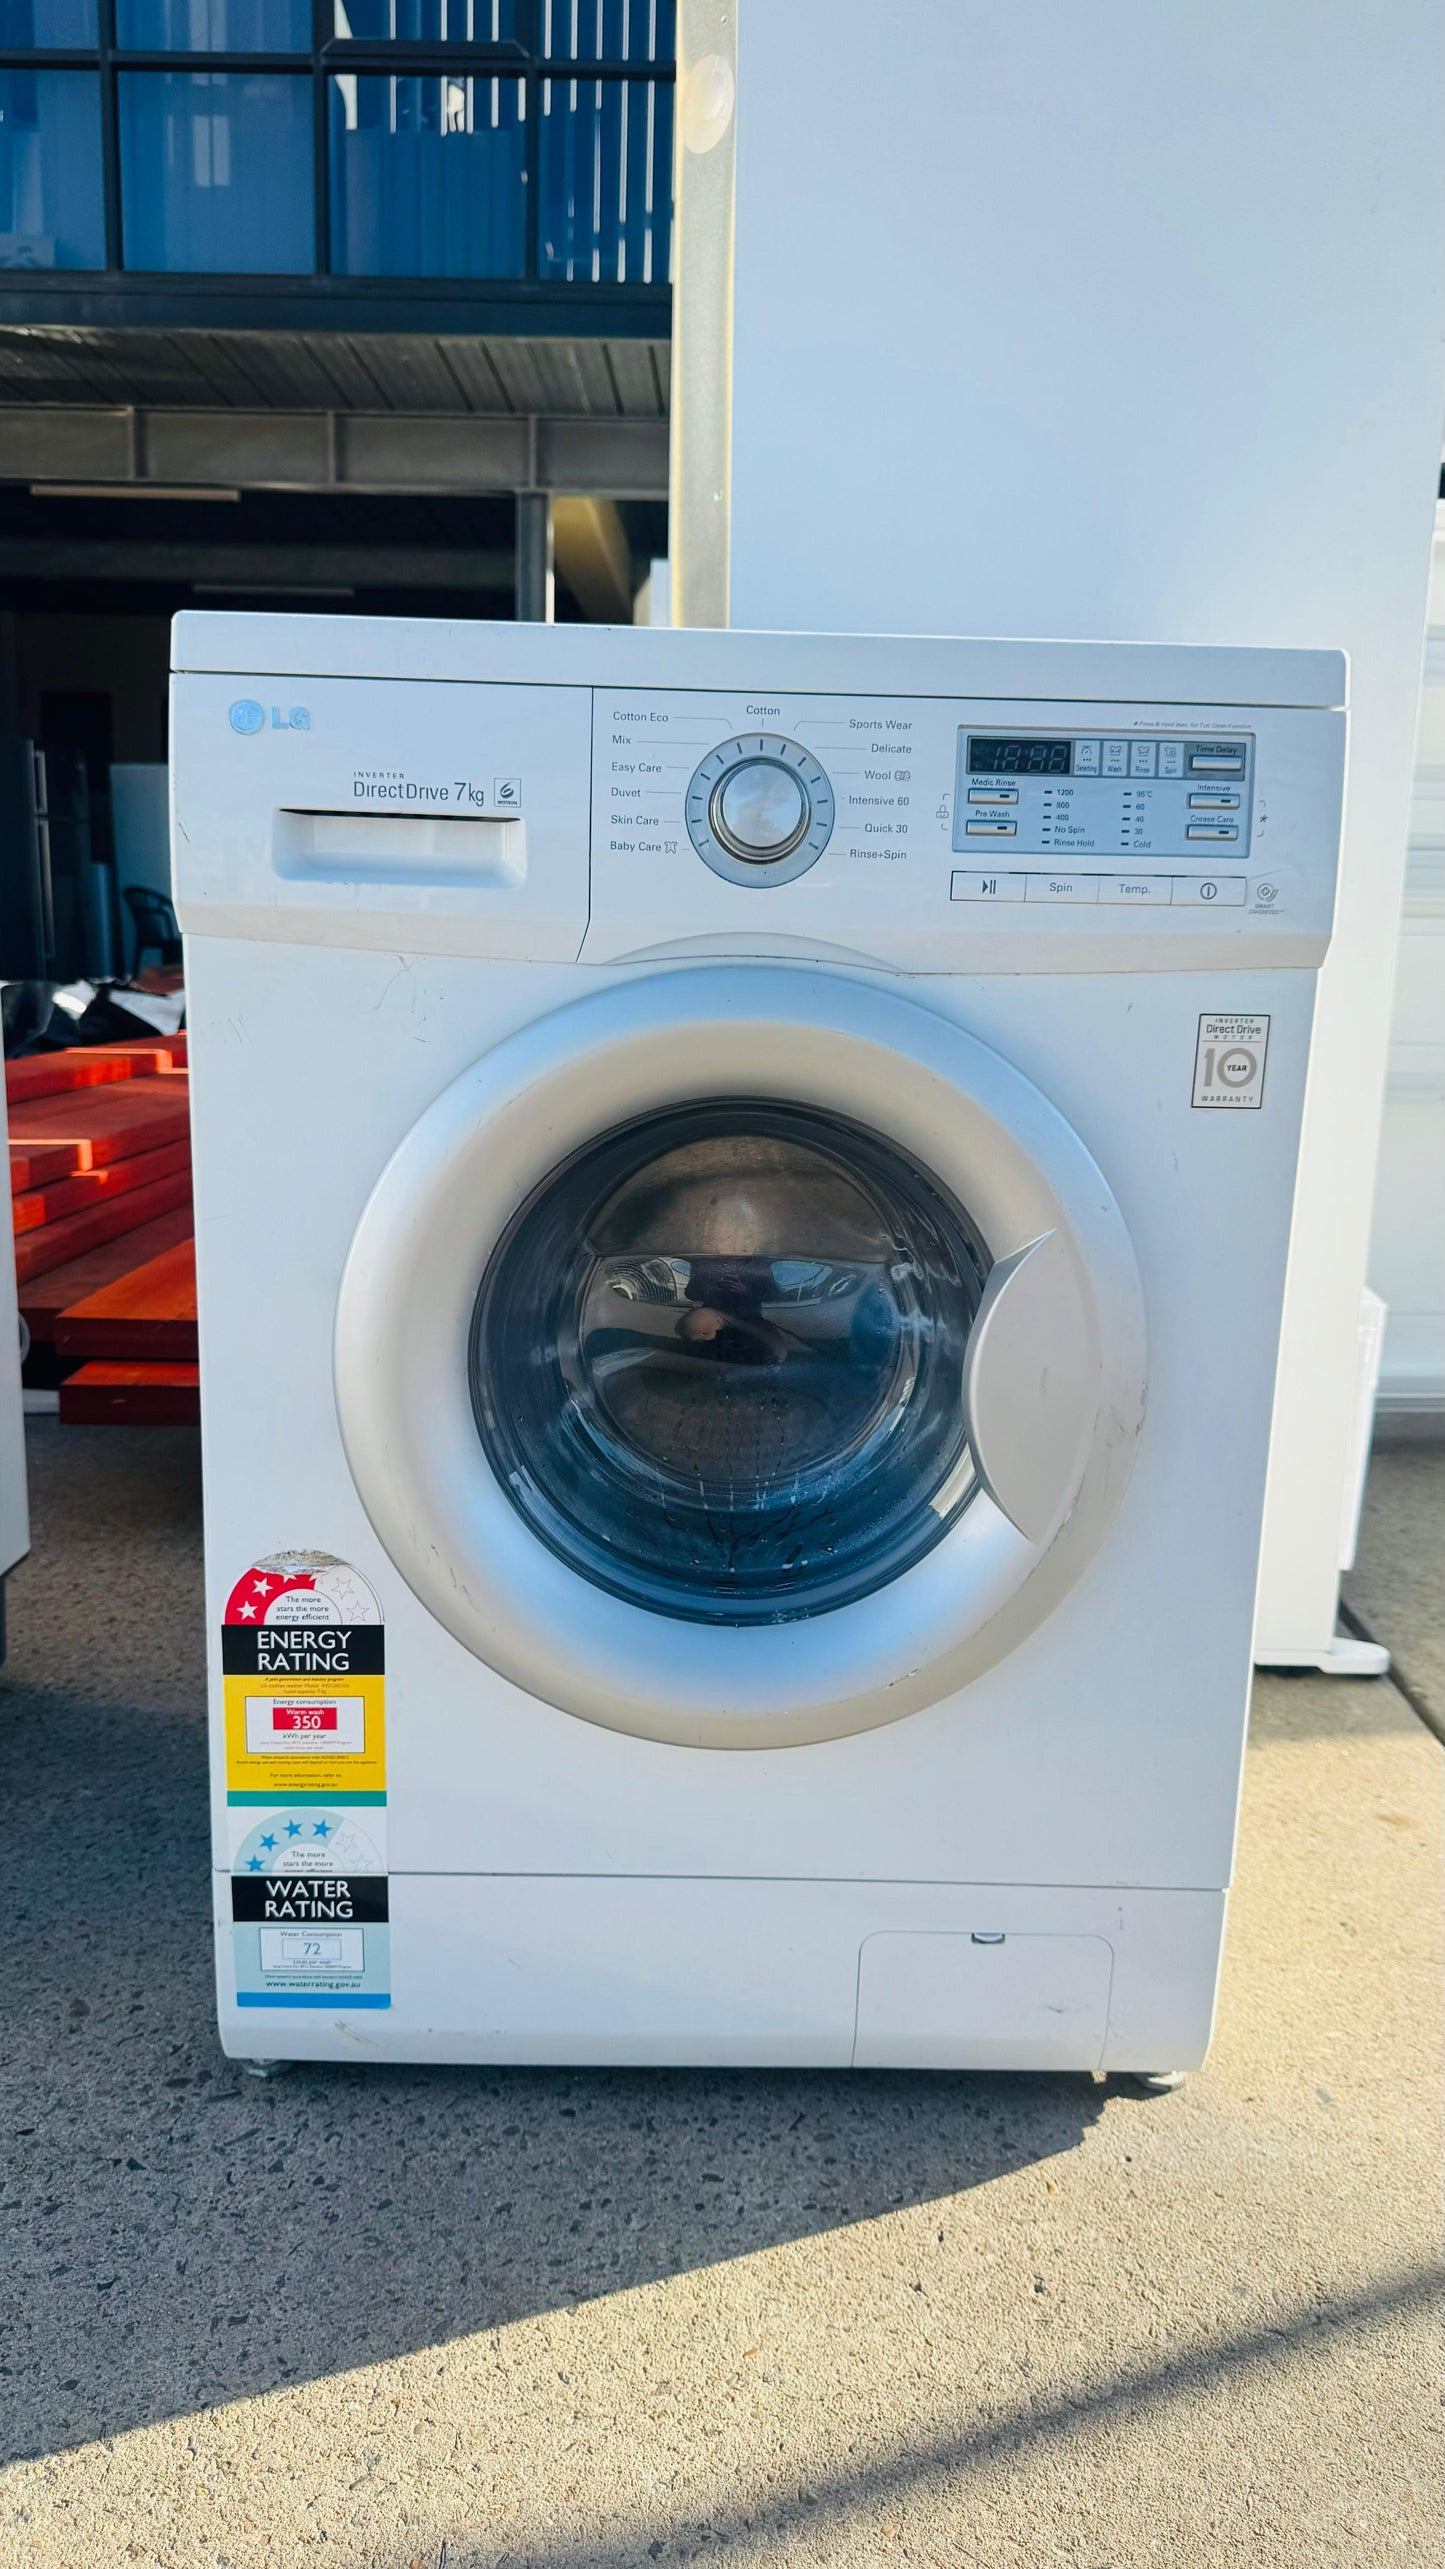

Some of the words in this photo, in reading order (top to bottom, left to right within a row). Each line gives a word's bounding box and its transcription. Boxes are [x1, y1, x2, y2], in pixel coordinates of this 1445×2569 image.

[746, 705, 780, 716] Cotton
[271, 706, 310, 730] LG
[613, 711, 647, 722] Cotton
[650, 712, 669, 722] Eco
[849, 719, 884, 732] Sports
[886, 720, 912, 730] Wear
[612, 735, 632, 745] Mix
[871, 743, 912, 754] Delicate
[1196, 745, 1214, 753] Time
[1216, 745, 1238, 755] Delay
[611, 763, 636, 775] Easy
[638, 763, 662, 773] Care
[1076, 765, 1097, 774] Detecting
[1165, 766, 1177, 774] Spin
[354, 771, 405, 779] INVERTER
[864, 770, 891, 780] Wool
[972, 778, 995, 786] Medic
[995, 779, 1016, 787] Rinse
[611, 787, 641, 798] Duvet
[849, 796, 895, 806] Intensive
[897, 796, 910, 806] 60
[989, 810, 1010, 818] Wash
[1190, 815, 1215, 823] Crease
[1217, 815, 1234, 823] Care
[611, 815, 634, 825] Skin
[636, 815, 659, 826] Care
[864, 823, 893, 834] Quick
[895, 824, 908, 834] 30
[1067, 826, 1085, 834] Spin
[610, 841, 636, 853] Baby
[638, 842, 662, 852] Care
[1054, 839, 1075, 847] Rinse
[1077, 839, 1095, 847] Hold
[850, 849, 907, 861] Rinse+Spin
[1049, 881, 1073, 893] Spin
[1118, 884, 1151, 895] Temp.
[1206, 1024, 1235, 1034] Direct
[1236, 1025, 1262, 1034] Drive
[1204, 1047, 1257, 1088] 10
[276, 1614, 299, 1622] energy
[256, 1630, 353, 1650] ENERGY
[257, 1652, 351, 1672] RATING
[293, 1716, 322, 1730] 350
[265, 1880, 351, 1898] WATER
[264, 1900, 354, 1919] RATING
[303, 1942, 321, 1956] 72
